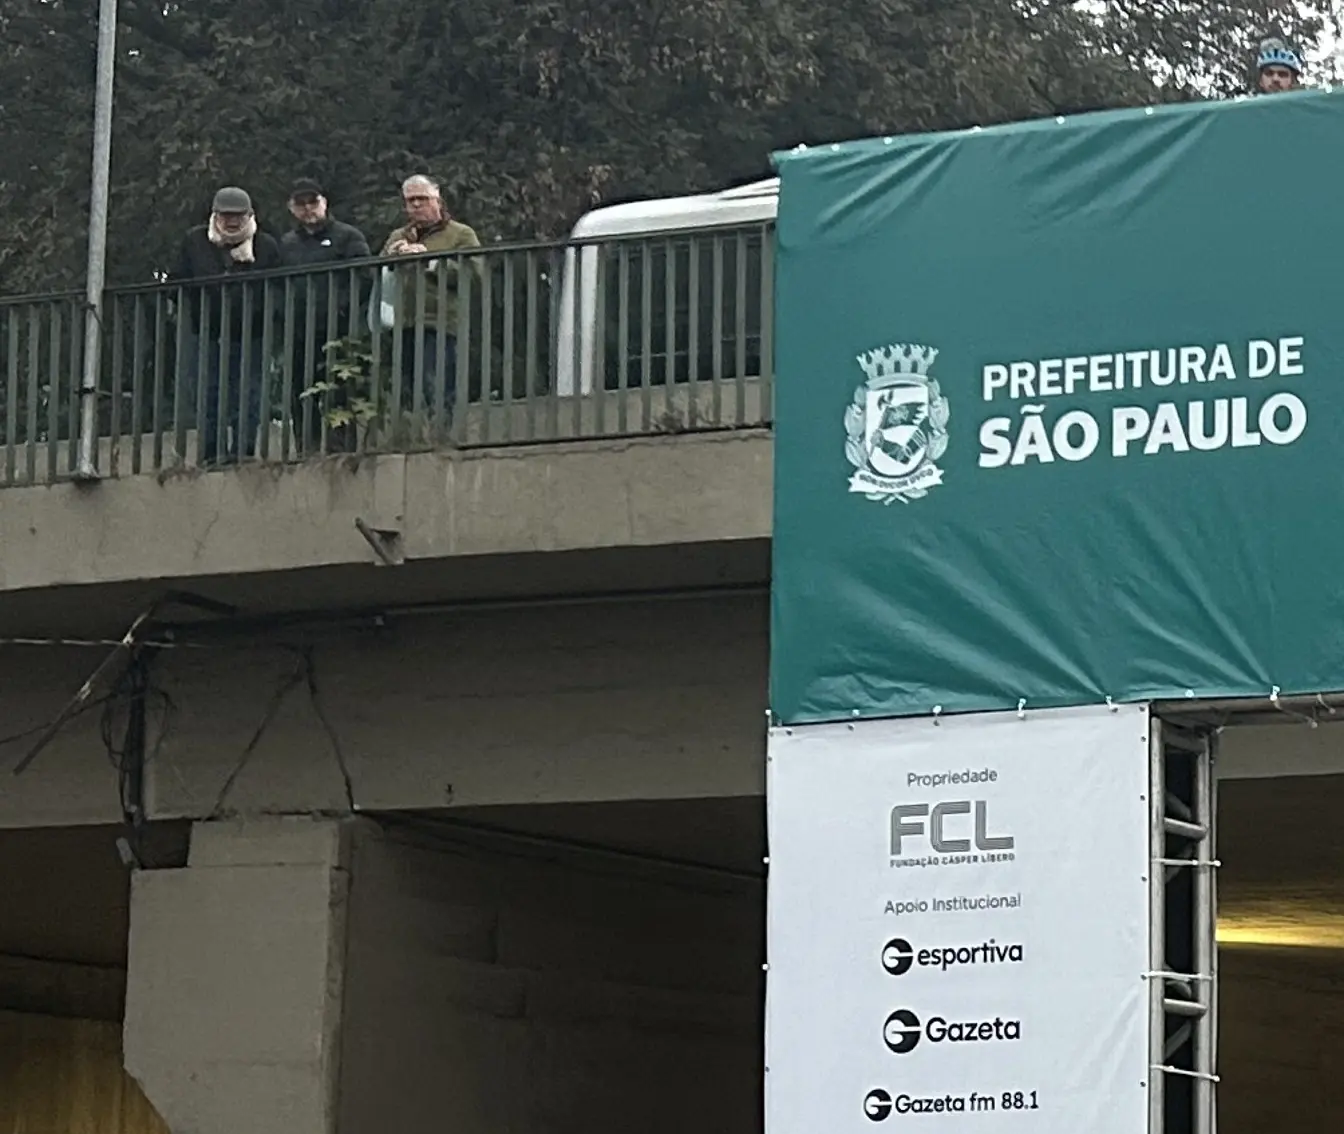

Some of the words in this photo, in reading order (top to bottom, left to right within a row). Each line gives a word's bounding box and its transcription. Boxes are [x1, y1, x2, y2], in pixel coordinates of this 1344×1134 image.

[983, 343, 1235, 400] PREFEITURA
[1248, 337, 1304, 377] DE
[979, 404, 1098, 467] SÃO
[1112, 393, 1307, 457] PAULO
[907, 767, 998, 788] Propriedade
[890, 799, 1015, 856] FCL
[884, 899, 929, 915] Apoio
[932, 893, 1022, 911] Institucional
[917, 939, 1023, 971] esportiva
[926, 1017, 1021, 1043] Gazeta
[895, 1093, 966, 1113] Gazeta
[970, 1093, 996, 1111] fm
[1002, 1090, 1040, 1110] 88.1
